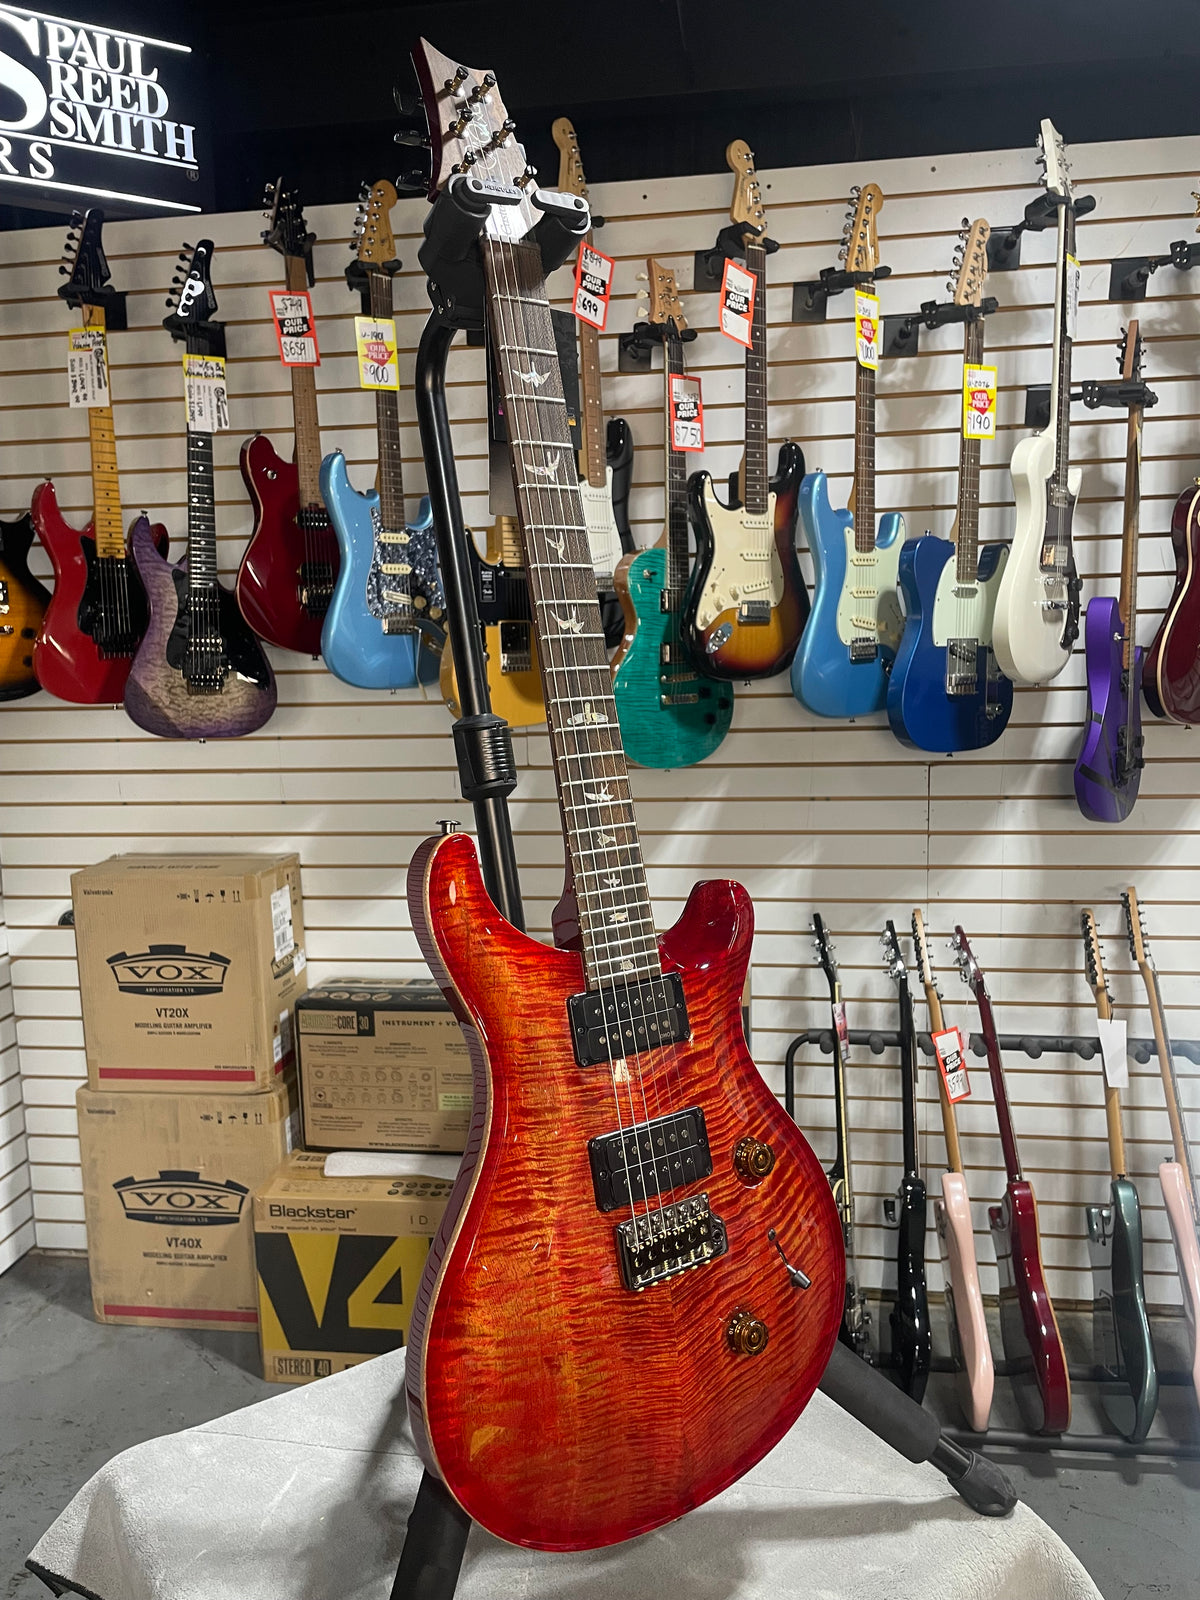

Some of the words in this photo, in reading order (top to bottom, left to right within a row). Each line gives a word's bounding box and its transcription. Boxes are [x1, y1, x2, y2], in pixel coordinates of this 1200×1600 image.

[44, 21, 158, 82] PAUL
[47, 60, 169, 118] REED
[49, 99, 197, 163] SMITH
[585, 274, 602, 286] OUR
[582, 280, 605, 295] PRICE
[729, 292, 745, 304] OUR
[577, 293, 598, 317] $699
[726, 299, 748, 313] PRICE
[283, 324, 308, 334] PRICE
[284, 318, 303, 327] OUR
[369, 344, 386, 353] OUR
[368, 352, 390, 360] PRICE
[363, 364, 389, 383] $900
[974, 392, 988, 400] OUR
[679, 403, 695, 411] OUR
[972, 399, 990, 408] PRICE
[677, 410, 698, 418] PRICE
[123, 965, 213, 980] VOX
[155, 1008, 189, 1018] VT20X
[184, 1022, 212, 1030] AMPLIFIER
[358, 1015, 370, 1030] 30
[946, 1052, 958, 1065] OUR
[130, 1192, 229, 1209] VOX
[269, 1204, 356, 1219] Blackstar
[166, 1236, 202, 1249] VT40X
[277, 1358, 312, 1376] STEREO
[316, 1359, 331, 1377] 40
